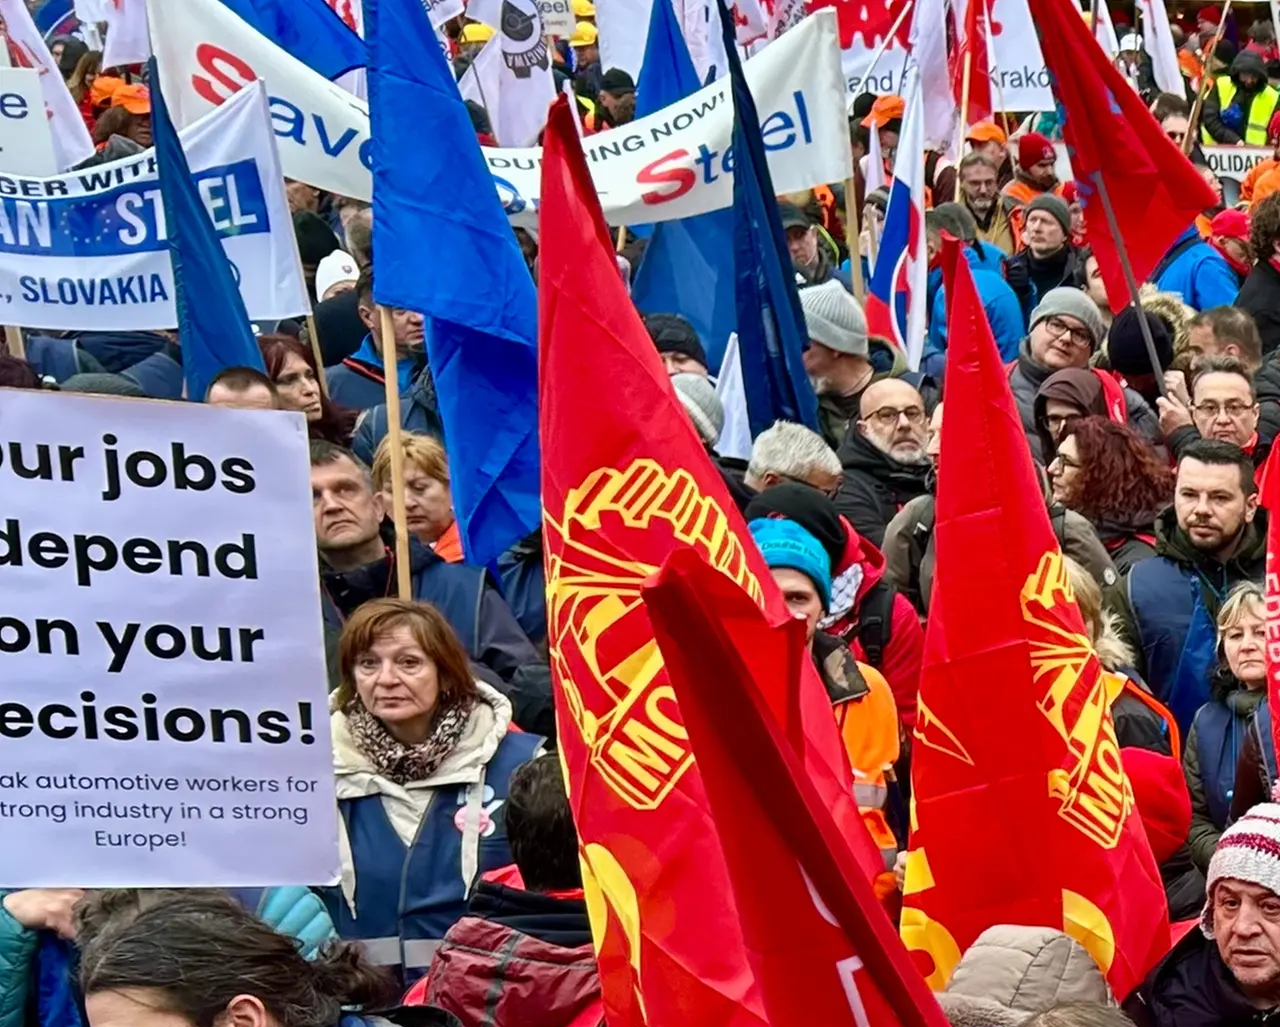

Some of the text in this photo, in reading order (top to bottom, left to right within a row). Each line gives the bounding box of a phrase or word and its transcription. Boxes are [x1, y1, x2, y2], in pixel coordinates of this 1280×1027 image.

[489, 91, 725, 171] DUING NOW!
[115, 169, 257, 246] STEL
[20, 274, 168, 305] SLOVAKIA
[0, 434, 254, 501] ur jobs
[0, 617, 263, 674] on your
[36, 773, 179, 793] automotive
[186, 773, 280, 794] workers
[286, 775, 318, 795] for
[74, 801, 172, 825] industry
[179, 802, 201, 818] in
[209, 808, 224, 819] a
[230, 805, 308, 826] strong
[95, 830, 187, 852] Europe!
